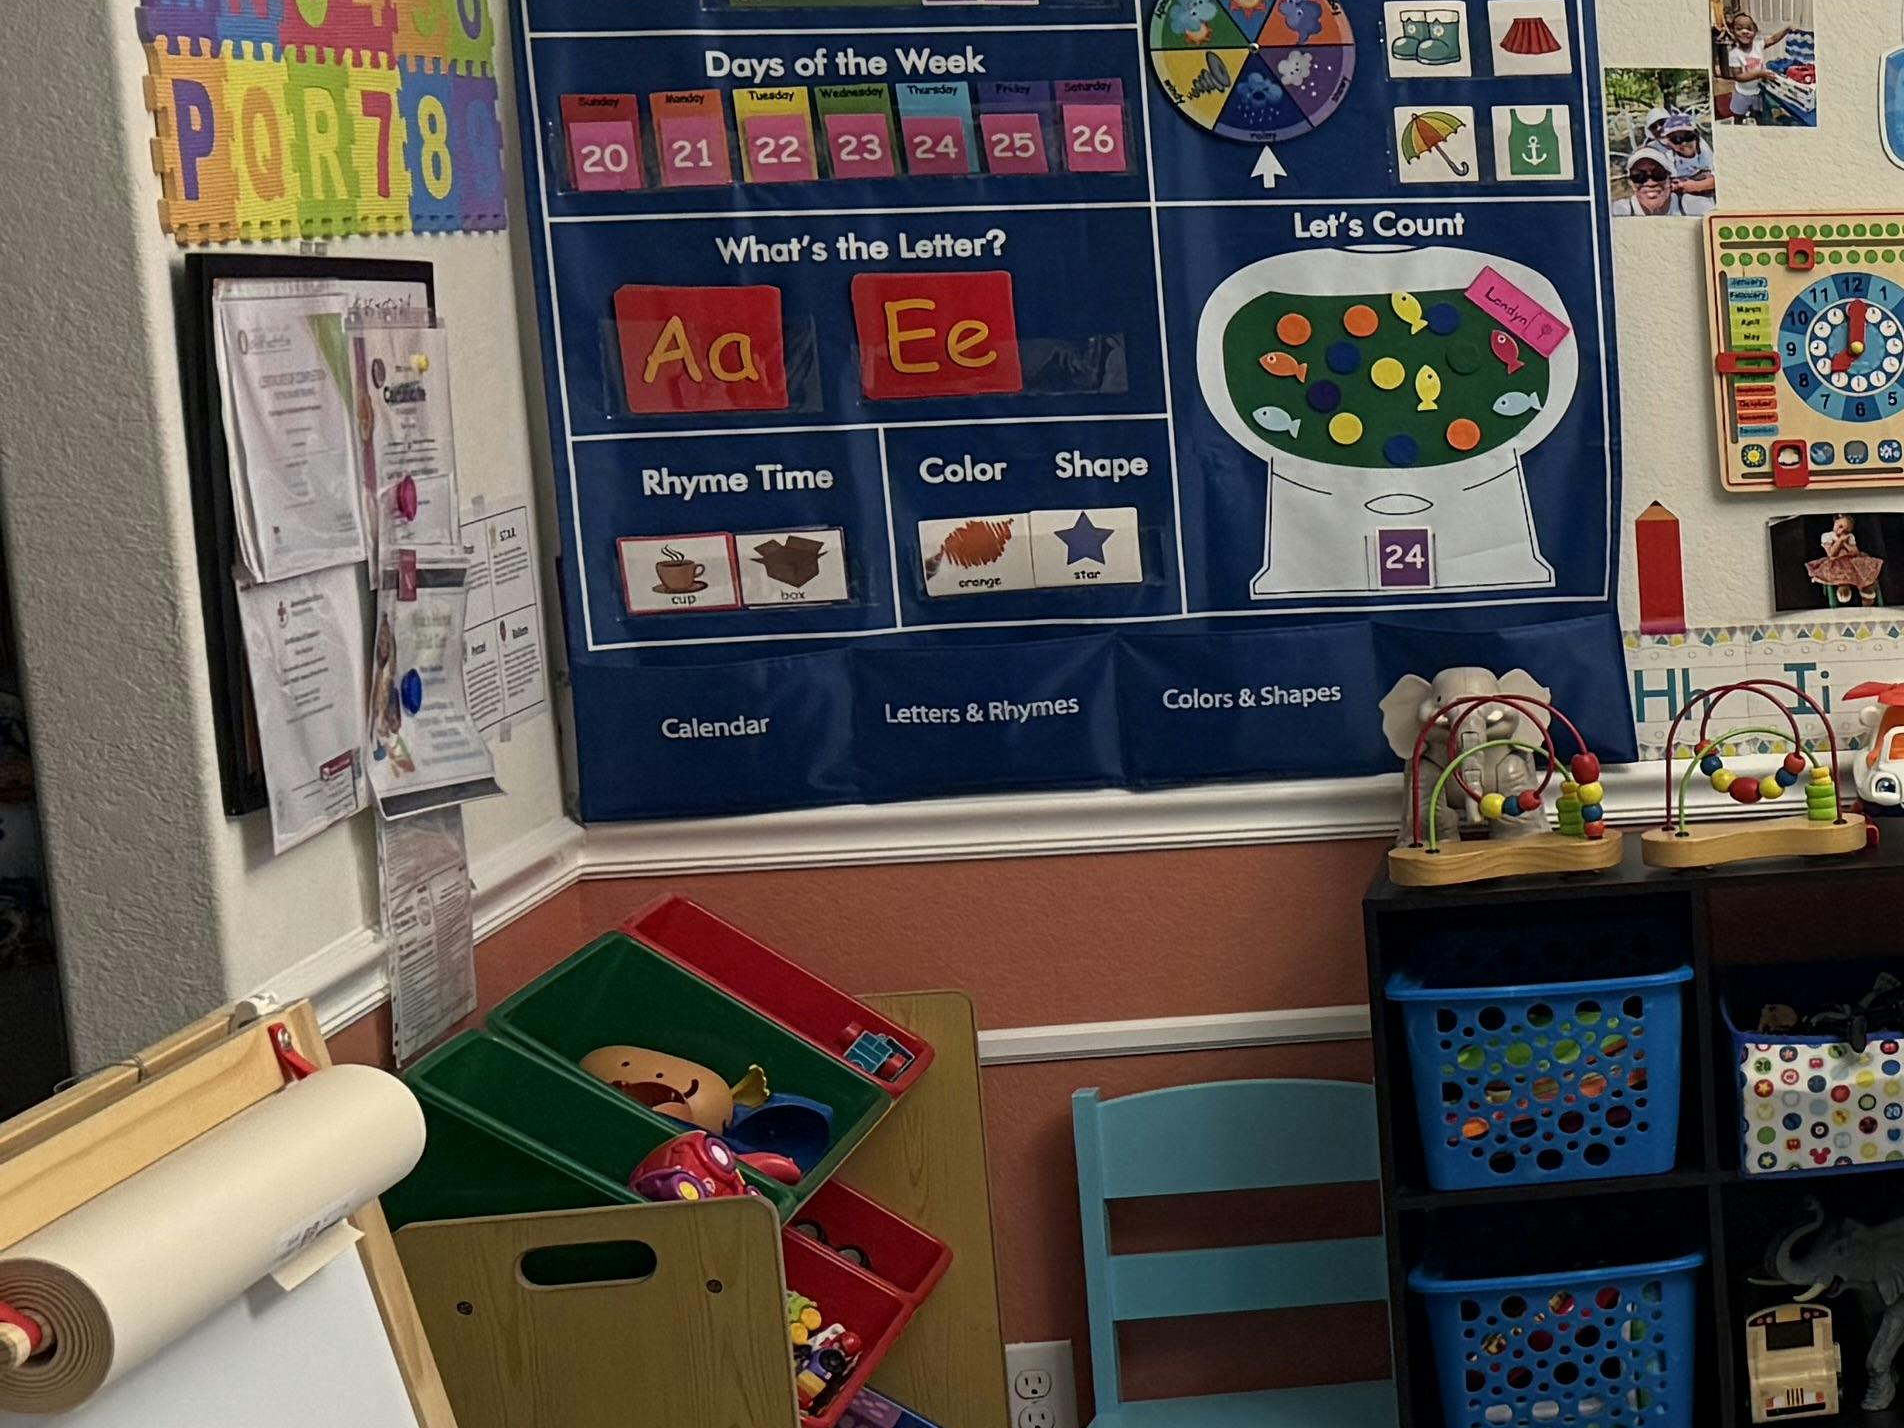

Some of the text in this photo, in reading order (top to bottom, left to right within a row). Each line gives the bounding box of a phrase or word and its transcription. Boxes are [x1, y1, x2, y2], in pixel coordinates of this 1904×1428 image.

[705, 46, 986, 83] Days of the Week
[748, 89, 795, 104] Tuesday
[819, 86, 884, 101] Wednesday
[756, 136, 801, 163] 22
[837, 135, 883, 161] 23
[913, 135, 958, 159] 24
[993, 133, 1035, 157] 25
[1072, 126, 1115, 153] 26
[581, 144, 629, 173] 20
[672, 140, 712, 168] 21
[1294, 211, 1465, 237] Let's Count
[716, 231, 1006, 264] What's the Letter?
[885, 299, 997, 373] Ee
[643, 316, 759, 384] Aa
[920, 455, 1007, 484] Color
[1055, 452, 1148, 484] Shape
[642, 464, 833, 500] Rhyme Time
[1385, 545, 1425, 569] 24
[1163, 683, 1341, 710] Colors & Shapes
[886, 695, 1080, 726] Letters & Rhymes
[662, 716, 769, 739] Calendar
